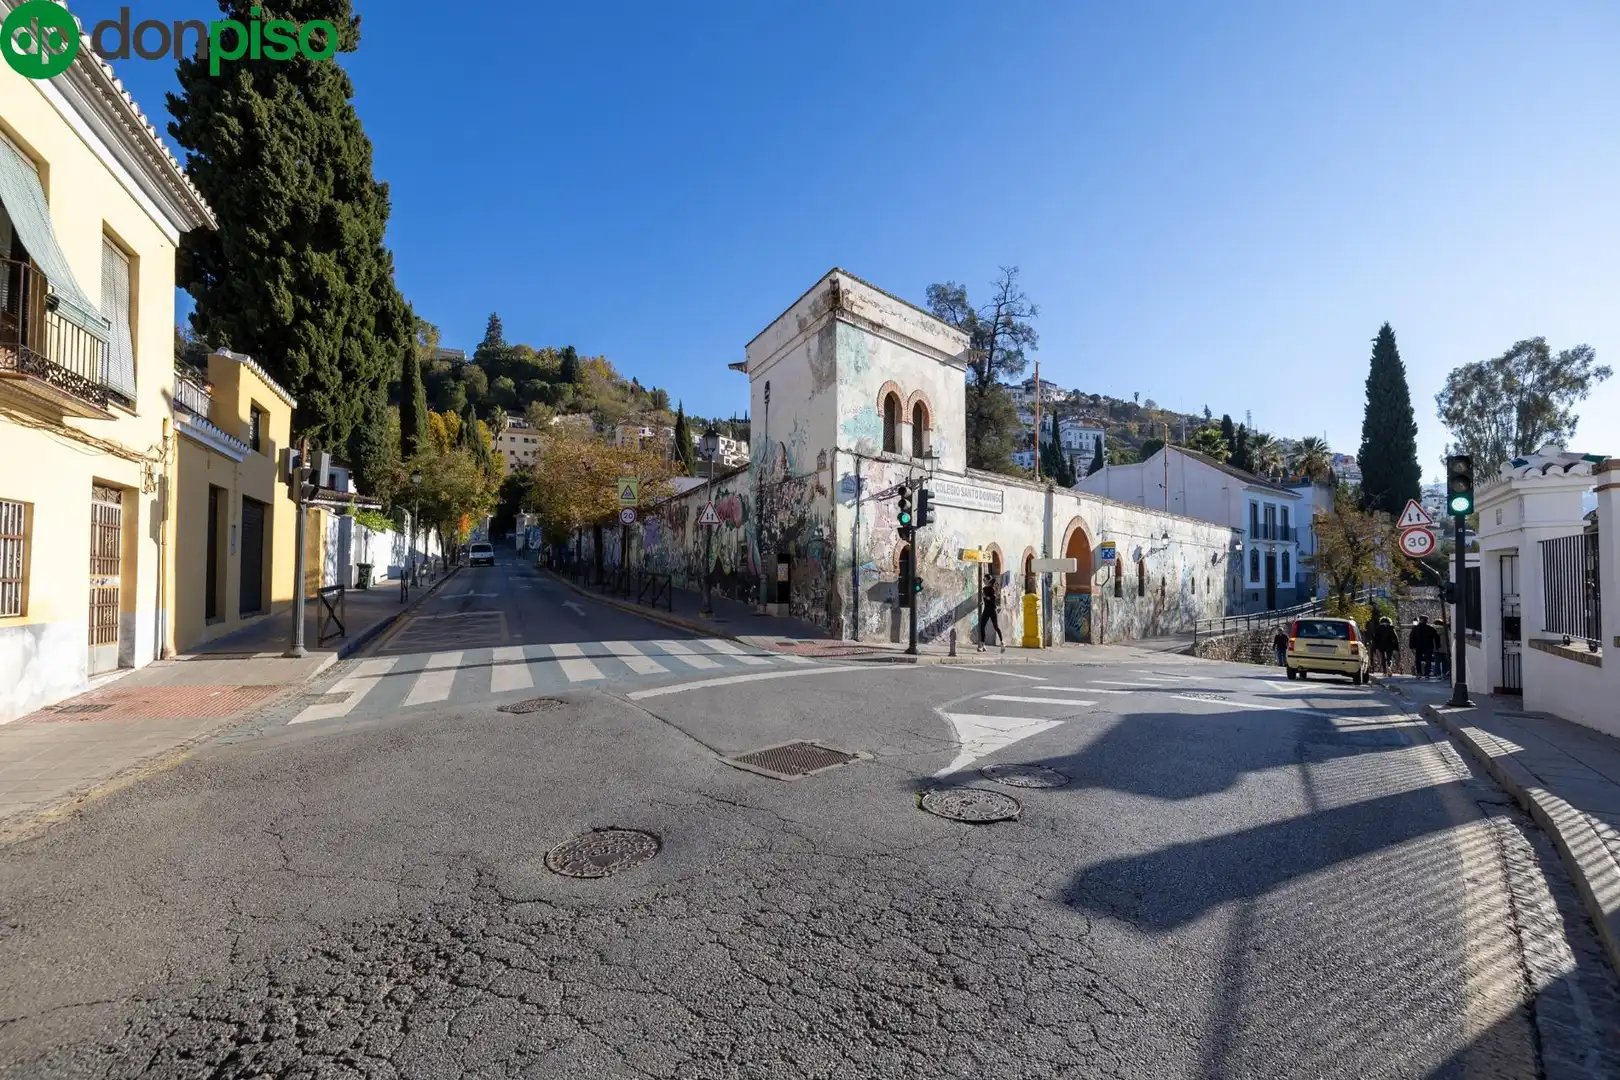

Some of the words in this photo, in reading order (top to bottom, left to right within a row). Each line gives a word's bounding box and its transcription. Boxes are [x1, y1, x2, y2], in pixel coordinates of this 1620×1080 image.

[935, 482, 961, 496] COLEGIO
[961, 486, 979, 499] SANTO
[979, 490, 1002, 503] DOMINGO
[623, 512, 633, 520] 20
[1408, 536, 1427, 547] 30
